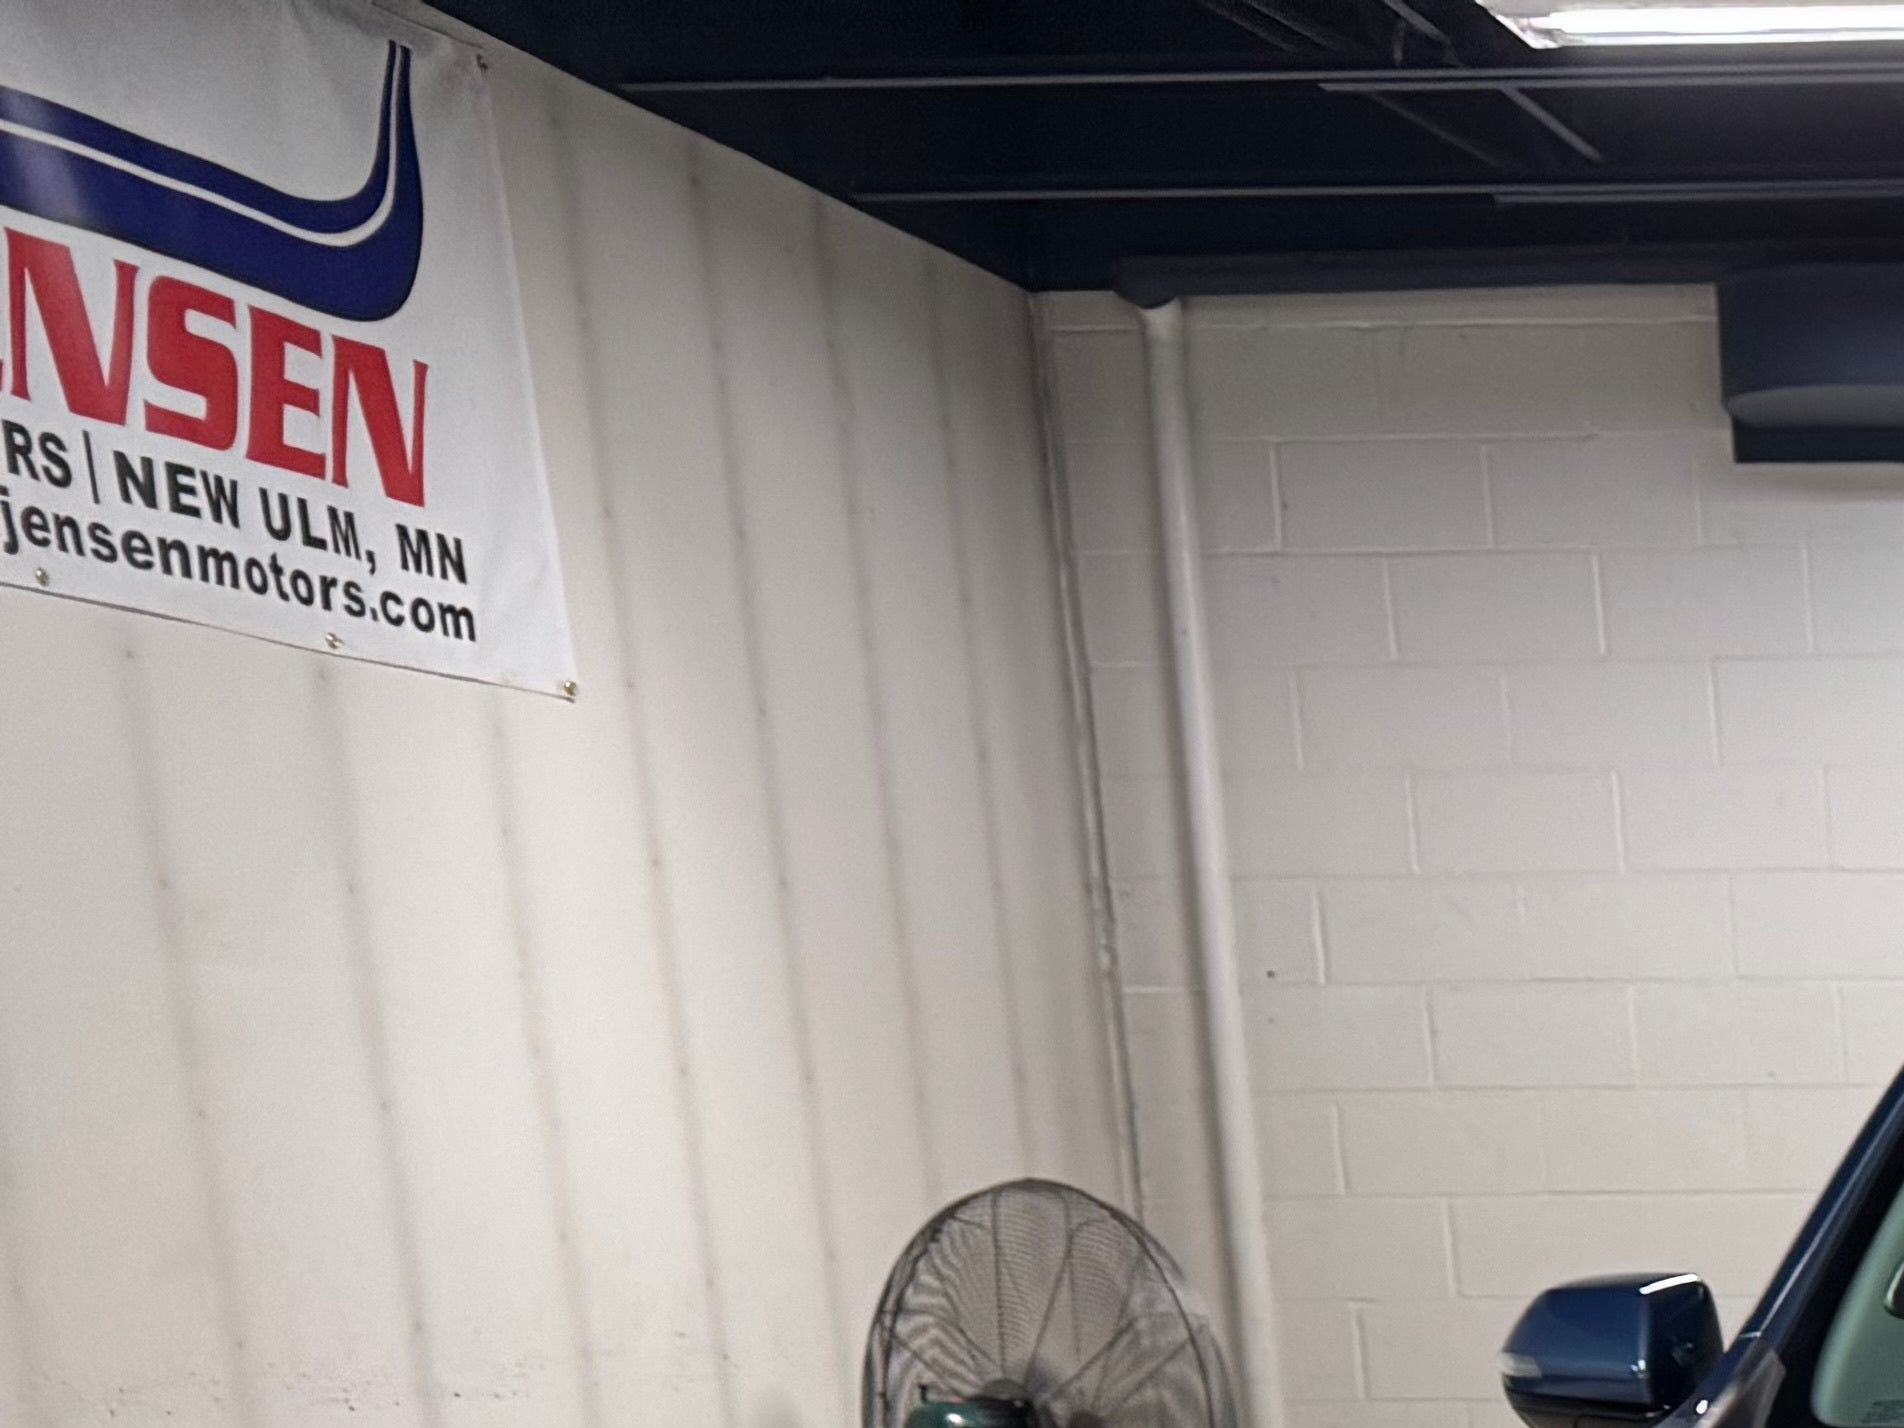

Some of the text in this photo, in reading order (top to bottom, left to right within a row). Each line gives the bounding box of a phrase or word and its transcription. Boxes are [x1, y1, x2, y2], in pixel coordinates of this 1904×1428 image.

[0, 227, 428, 507] NSEN
[1, 485, 477, 642] jensenmotors.com
[113, 450, 240, 529] NEW
[259, 486, 376, 576] ULM,
[395, 523, 468, 585] MN
